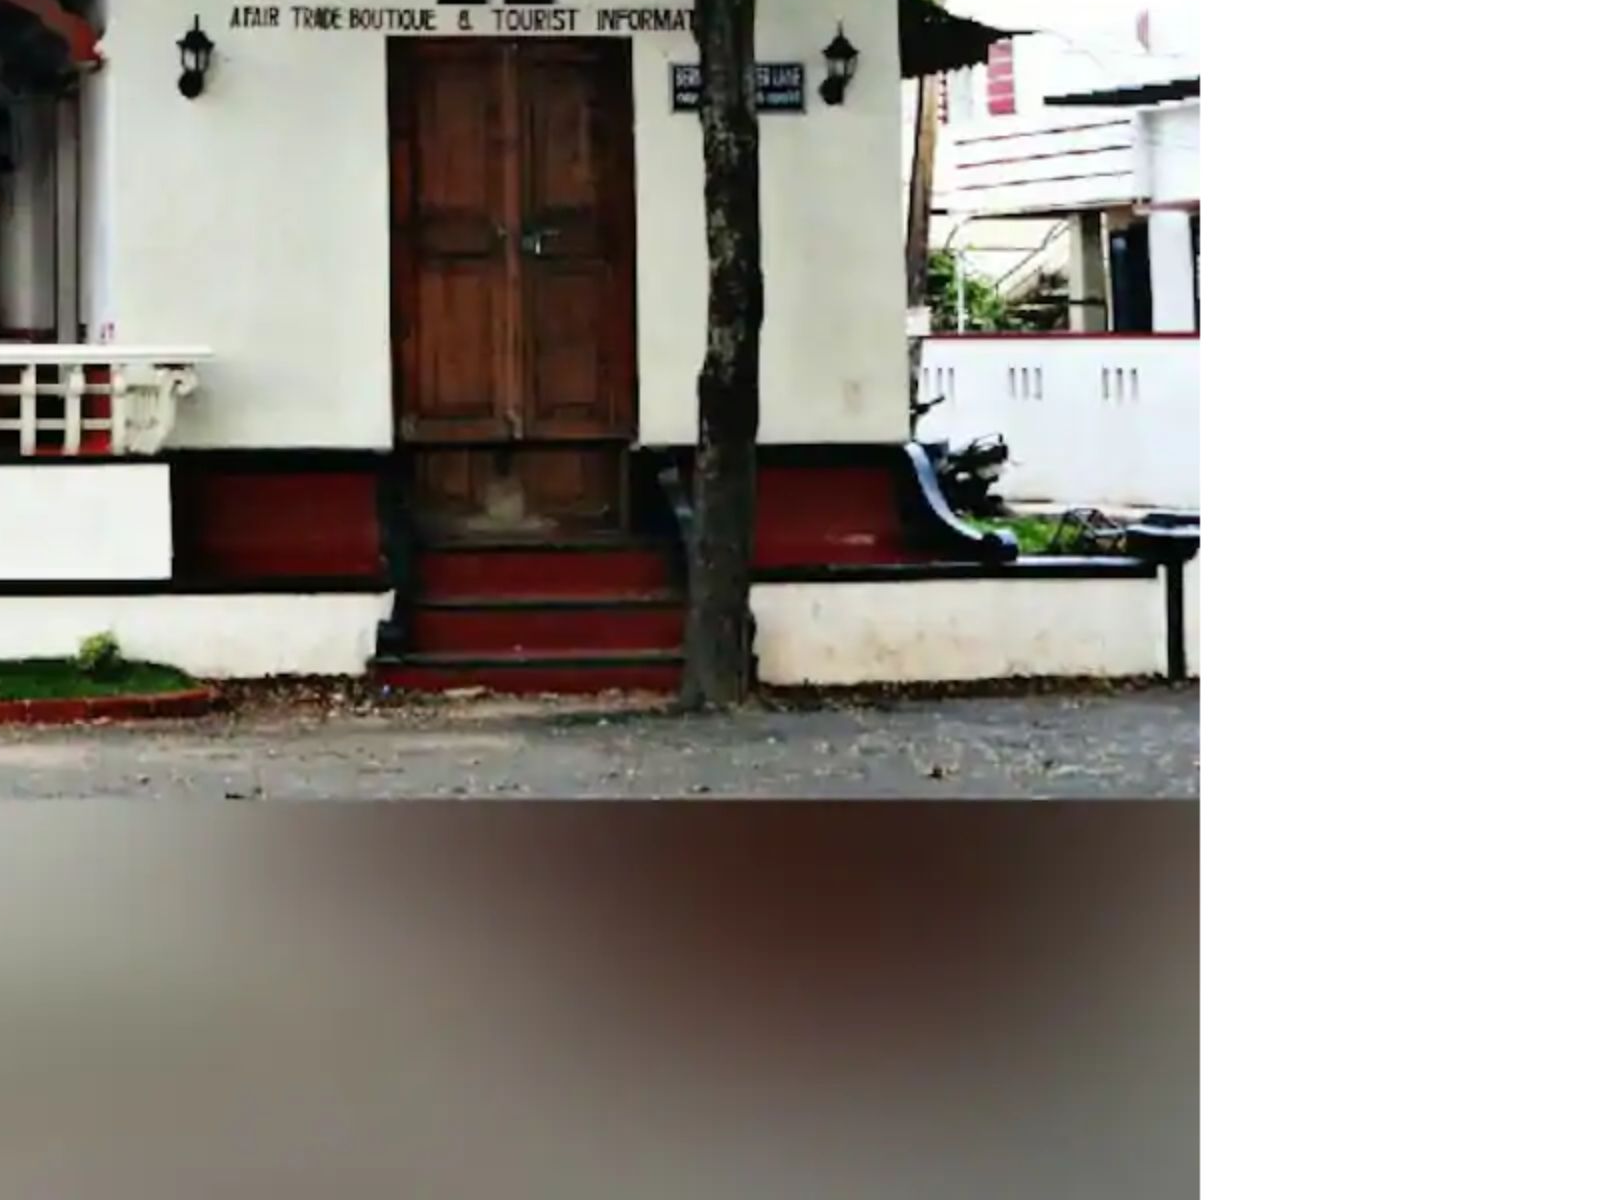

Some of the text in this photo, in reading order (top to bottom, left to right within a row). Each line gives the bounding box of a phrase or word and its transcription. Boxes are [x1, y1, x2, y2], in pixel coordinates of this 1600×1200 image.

[291, 6, 344, 30] TRADE
[349, 7, 438, 31] BOUTIQUE
[457, 9, 474, 31] &
[492, 8, 580, 31] TOURIST
[597, 8, 699, 32] INFORMAT
